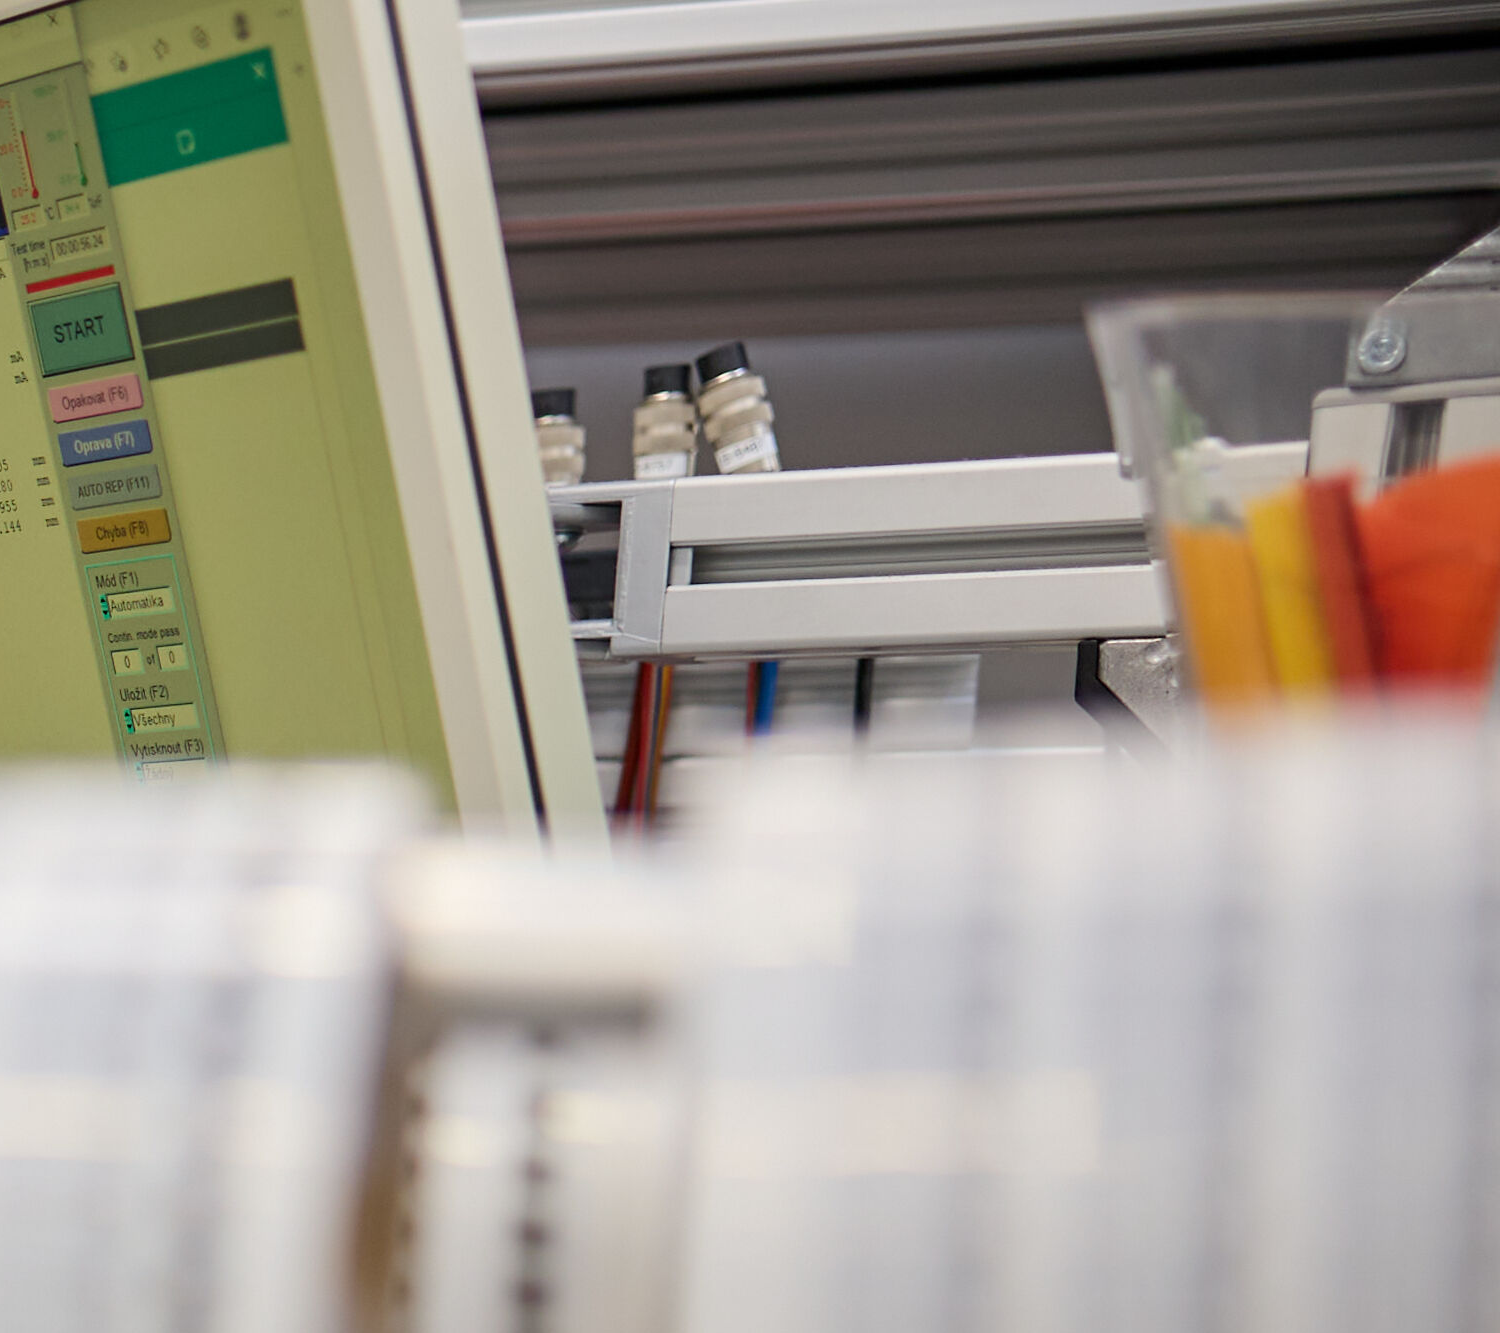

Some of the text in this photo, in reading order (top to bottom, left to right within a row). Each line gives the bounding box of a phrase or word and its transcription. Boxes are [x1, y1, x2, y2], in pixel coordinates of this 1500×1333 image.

[54, 315, 105, 343] START
[10, 351, 24, 364] mA
[14, 371, 29, 385] mA
[62, 386, 129, 412] Opakovat (F6)
[74, 430, 135, 456] Oprava (F7)
[78, 475, 150, 499] AUTO REP (F11)
[96, 520, 149, 542] Chyba (F8)
[95, 571, 139, 589] Mód (F1)
[110, 595, 164, 613] Automatika
[137, 627, 158, 640] mode
[160, 626, 180, 639] pass
[124, 650, 175, 669] 0 of 0
[119, 685, 169, 702] Uložit (F2)
[133, 712, 176, 728] Všechny
[130, 738, 205, 759] Vytisknout (F3)
